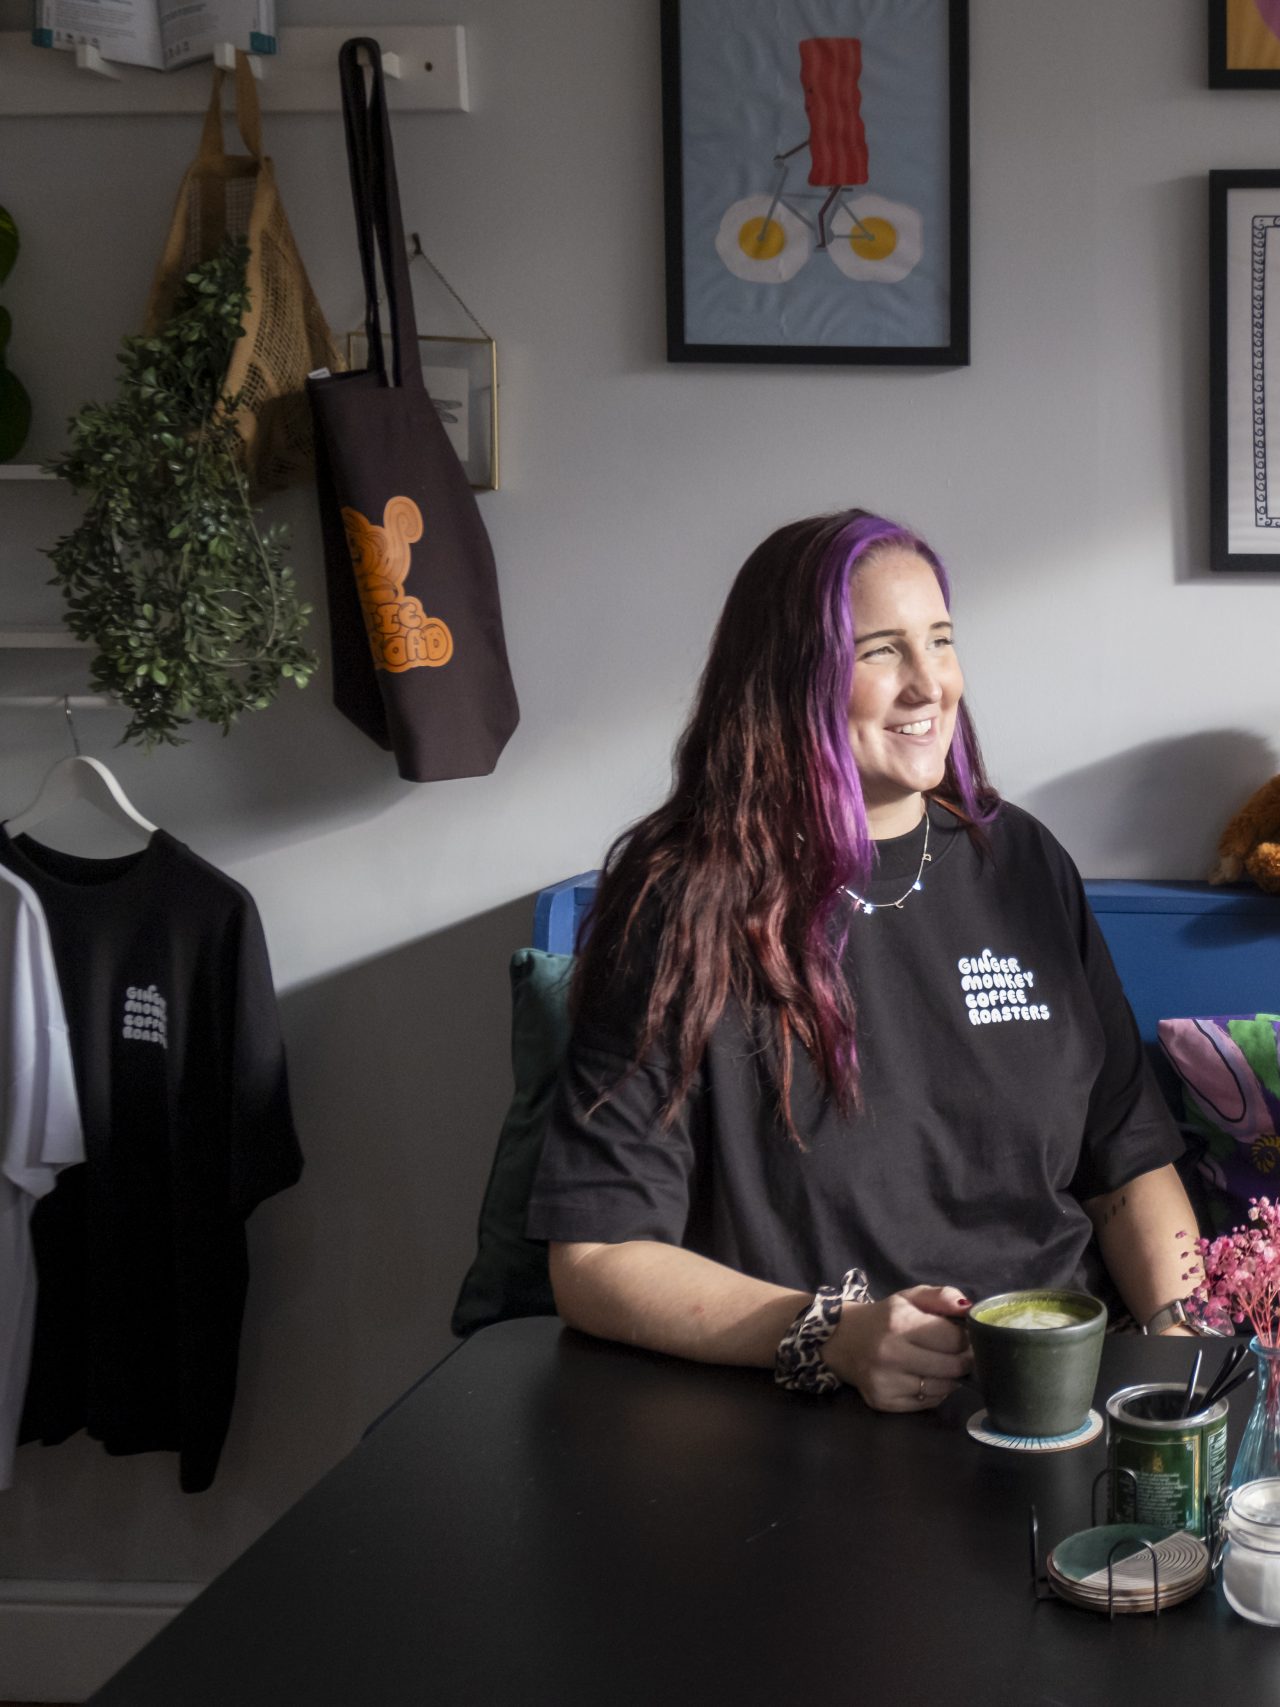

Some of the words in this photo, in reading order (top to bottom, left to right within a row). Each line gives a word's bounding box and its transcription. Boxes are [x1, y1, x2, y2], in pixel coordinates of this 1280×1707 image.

[957, 948, 1021, 975] GINGER
[961, 971, 1034, 992] MONKEY
[965, 989, 1028, 1009] COFFEE
[968, 1004, 1050, 1026] ROASTERS
